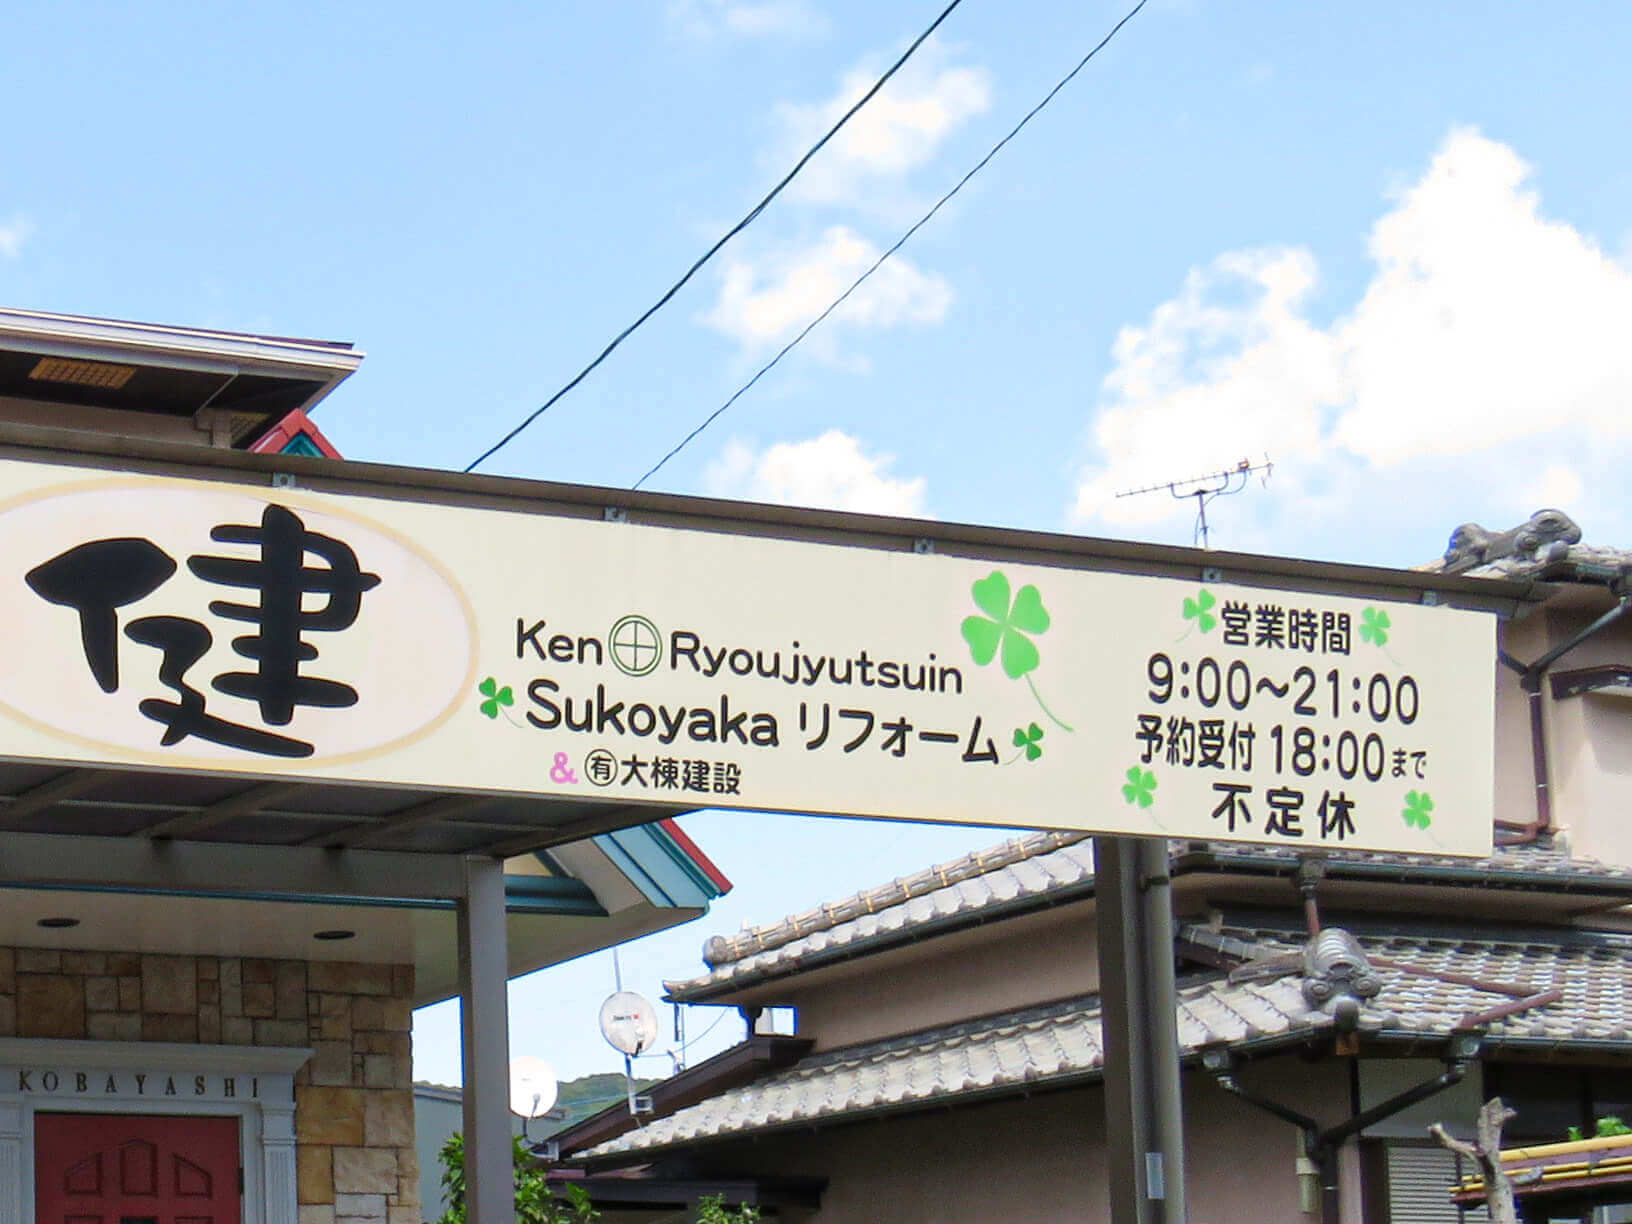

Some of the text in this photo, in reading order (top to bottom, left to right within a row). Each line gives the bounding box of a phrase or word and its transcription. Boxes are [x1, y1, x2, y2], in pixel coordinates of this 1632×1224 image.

[24, 502, 383, 759] 健
[515, 616, 964, 695] Ken Ryoujyutsuin
[1220, 600, 1353, 657] 営業時間
[524, 677, 1001, 766] Sukoyaka リフォーム
[548, 751, 579, 785] &
[1211, 782, 1357, 841] 不定休
[18, 1068, 259, 1099] KOBAYASHI
